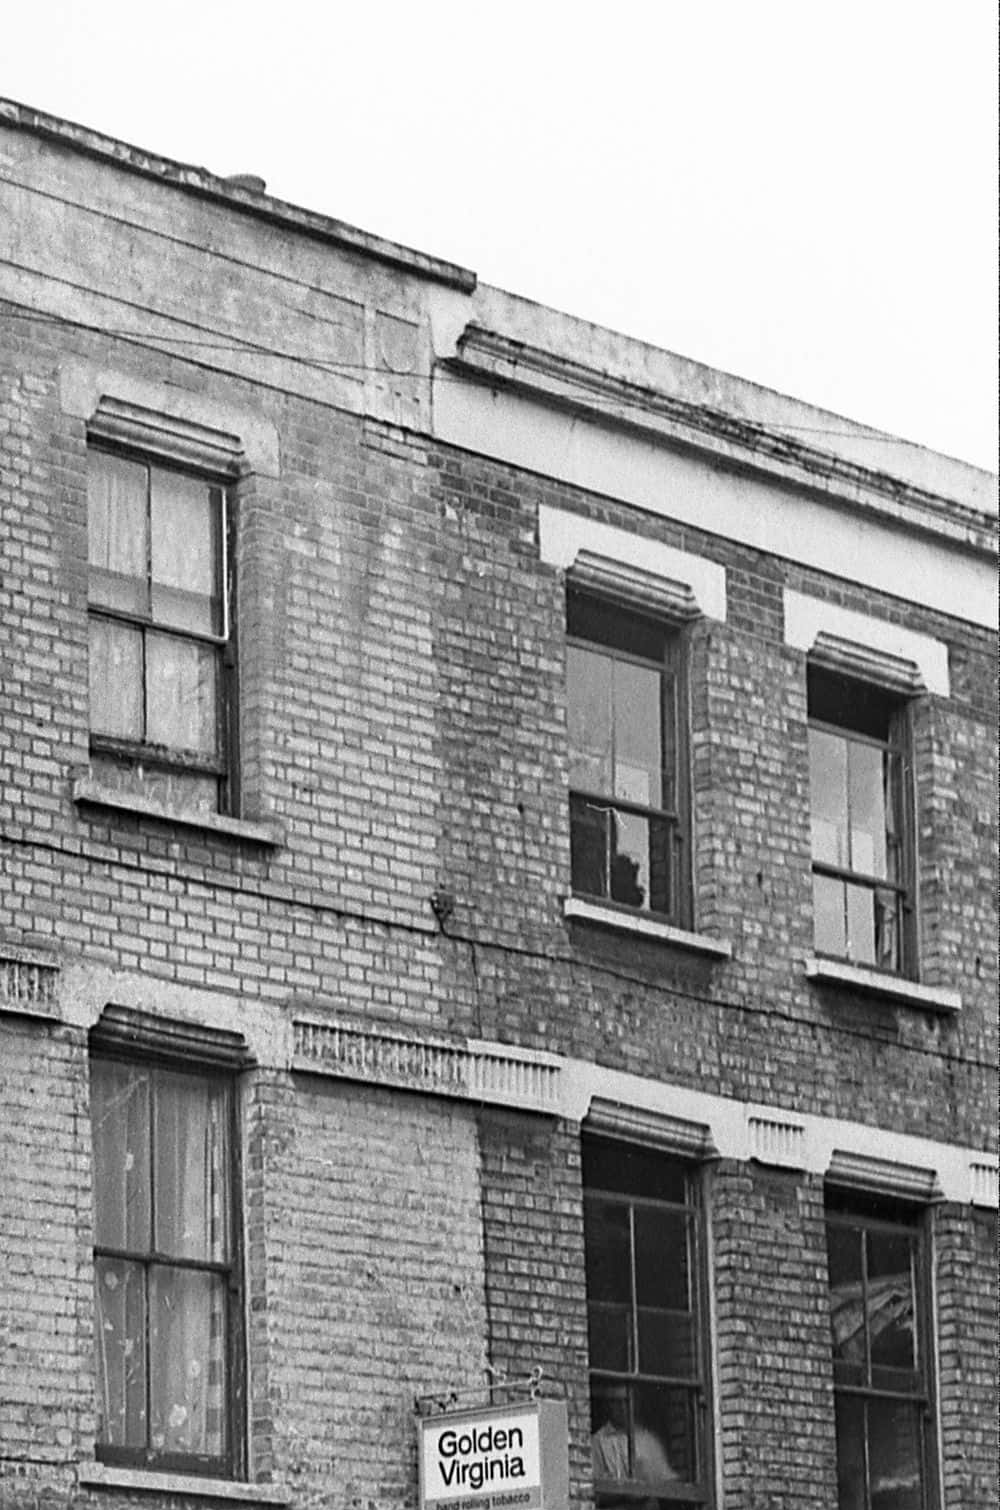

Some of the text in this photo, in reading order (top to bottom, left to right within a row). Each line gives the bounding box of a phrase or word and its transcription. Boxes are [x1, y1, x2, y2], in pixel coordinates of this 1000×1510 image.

[438, 1425, 524, 1458] Golden
[438, 1453, 526, 1490] Virginia
[492, 1492, 530, 1507] tobacco
